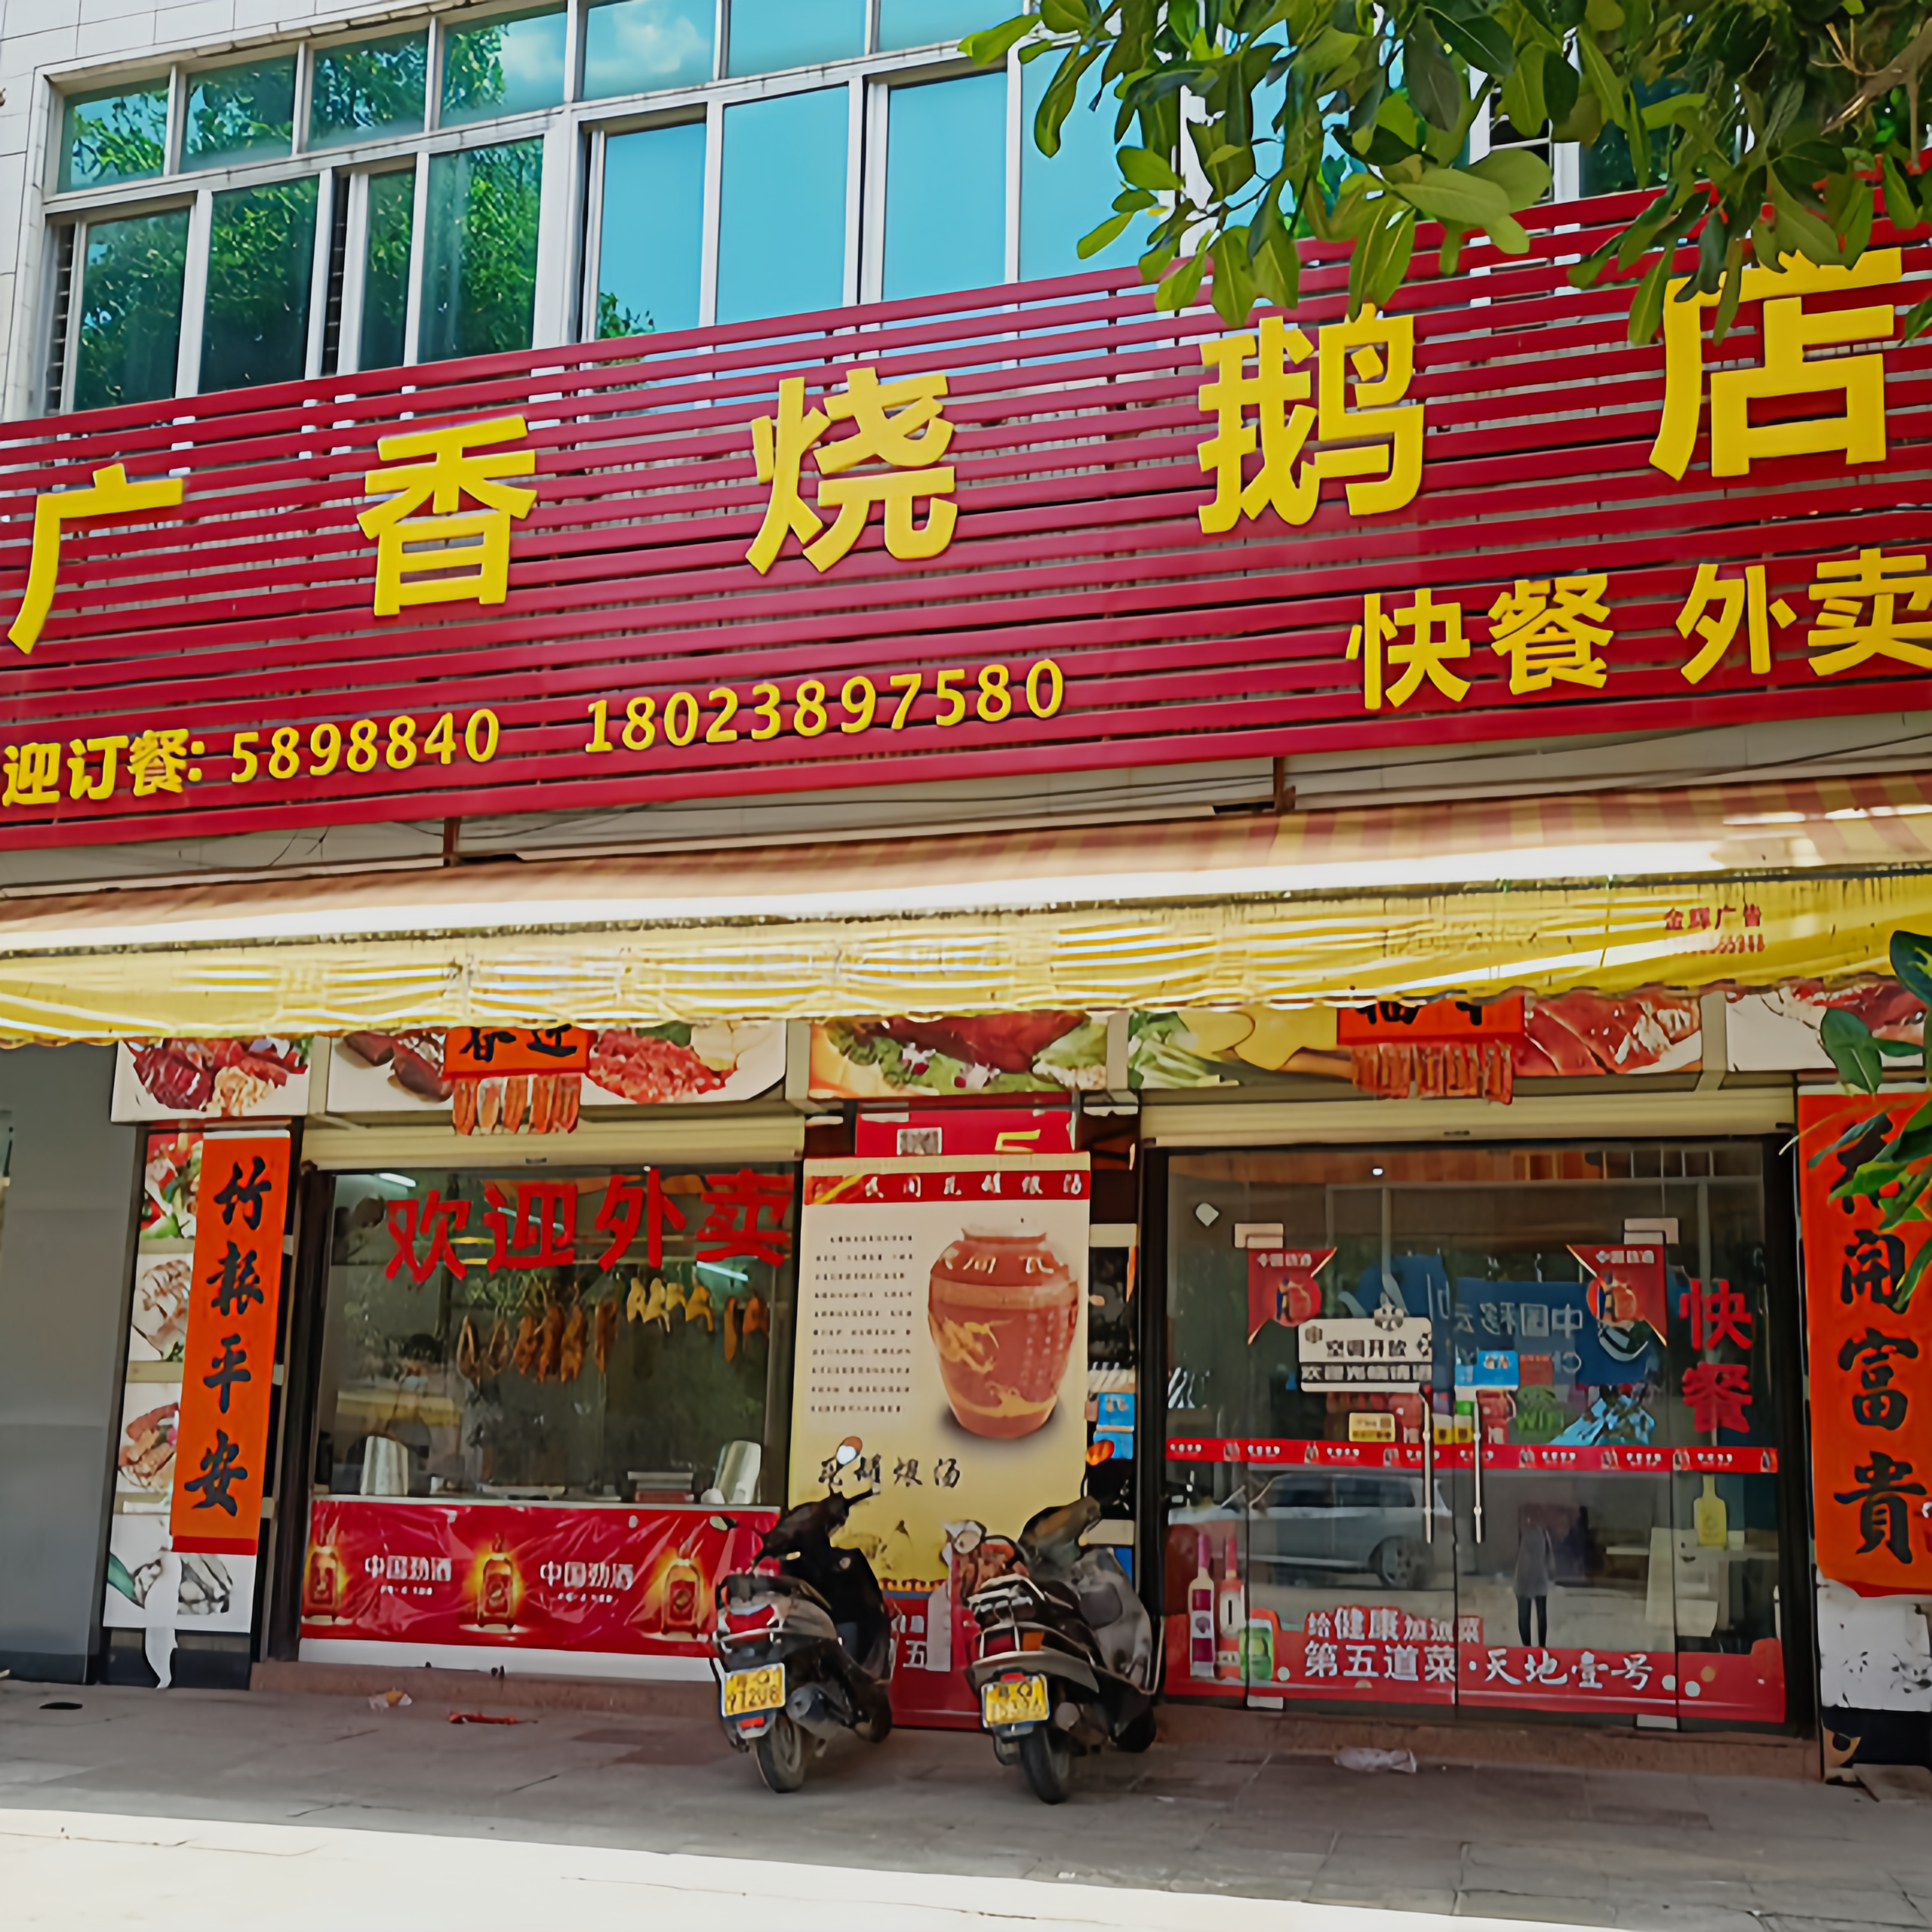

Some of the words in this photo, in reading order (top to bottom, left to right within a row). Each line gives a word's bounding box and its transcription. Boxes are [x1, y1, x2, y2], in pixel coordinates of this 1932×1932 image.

[8, 246, 1903, 655] 广香烧鹅店
[585, 659, 1063, 752] 18023897580
[1346, 571, 1614, 710] 快餐
[1675, 549, 1932, 685] 外卖
[385, 1168, 794, 1283] 欢迎外卖
[1679, 1278, 1752, 1433] 快餐
